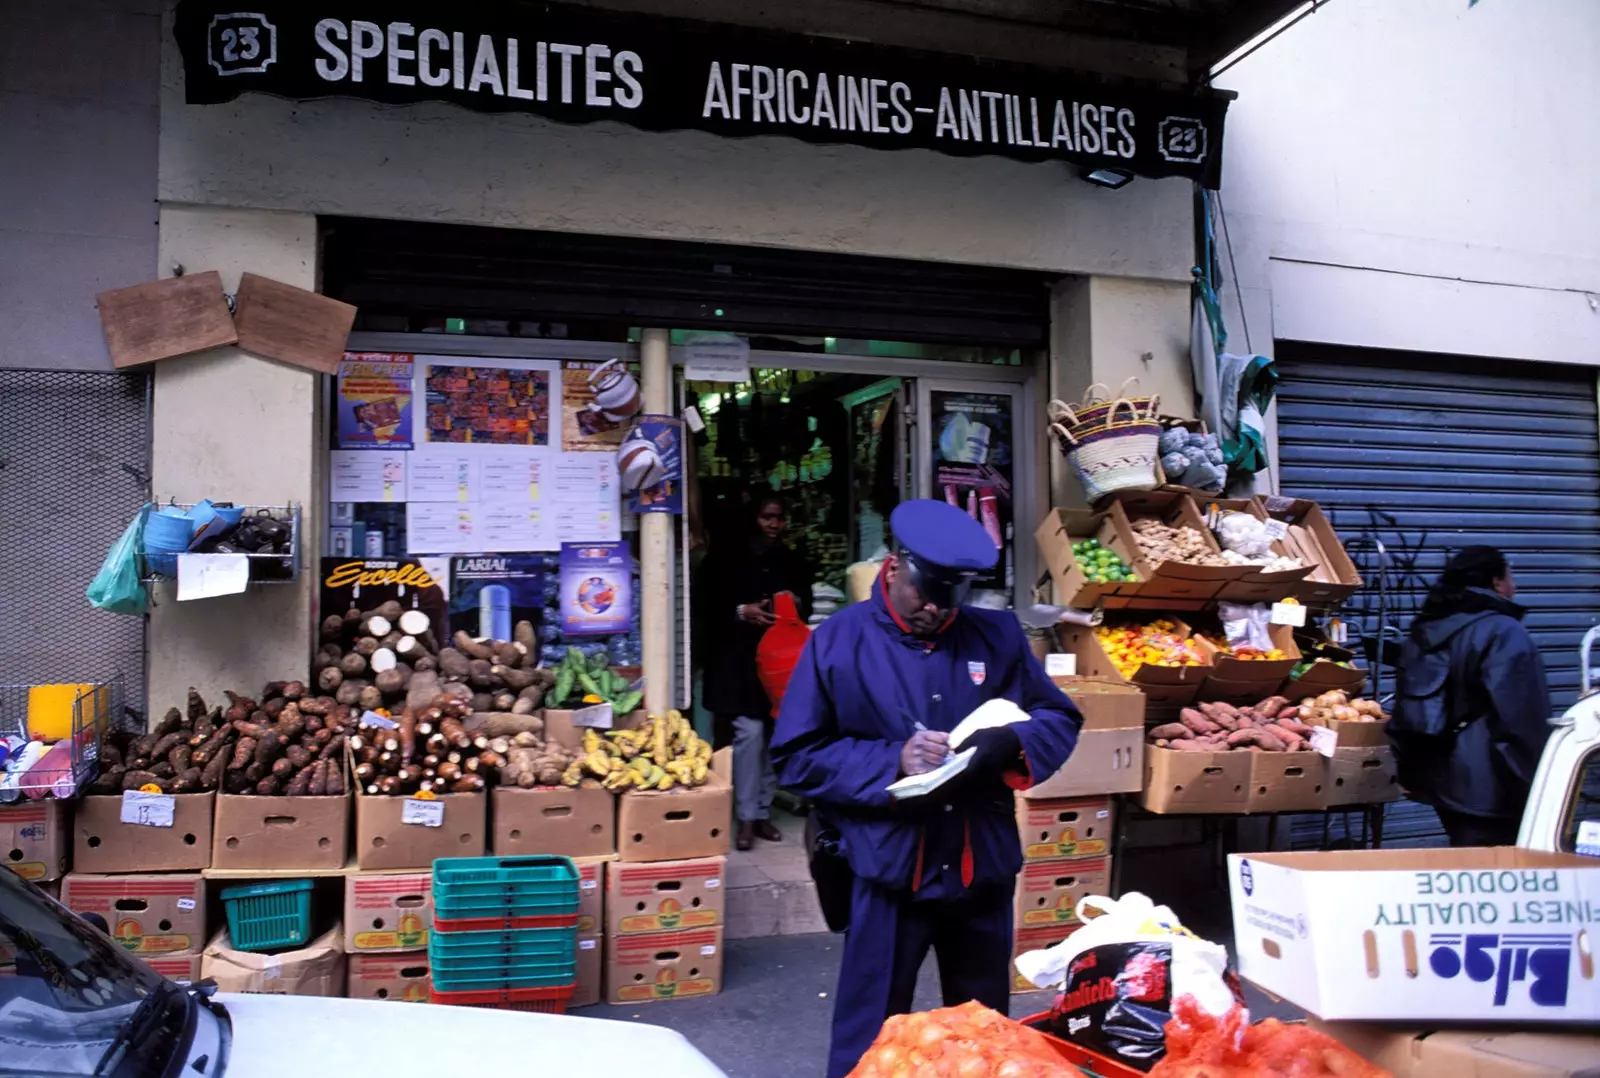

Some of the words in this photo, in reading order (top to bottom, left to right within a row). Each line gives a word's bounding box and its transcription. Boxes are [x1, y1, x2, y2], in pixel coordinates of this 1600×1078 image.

[221, 26, 260, 62] 23
[1169, 126, 1197, 153] 23
[1416, 871, 1559, 895] PRODUCE
[1374, 902, 1498, 926] QUALITY
